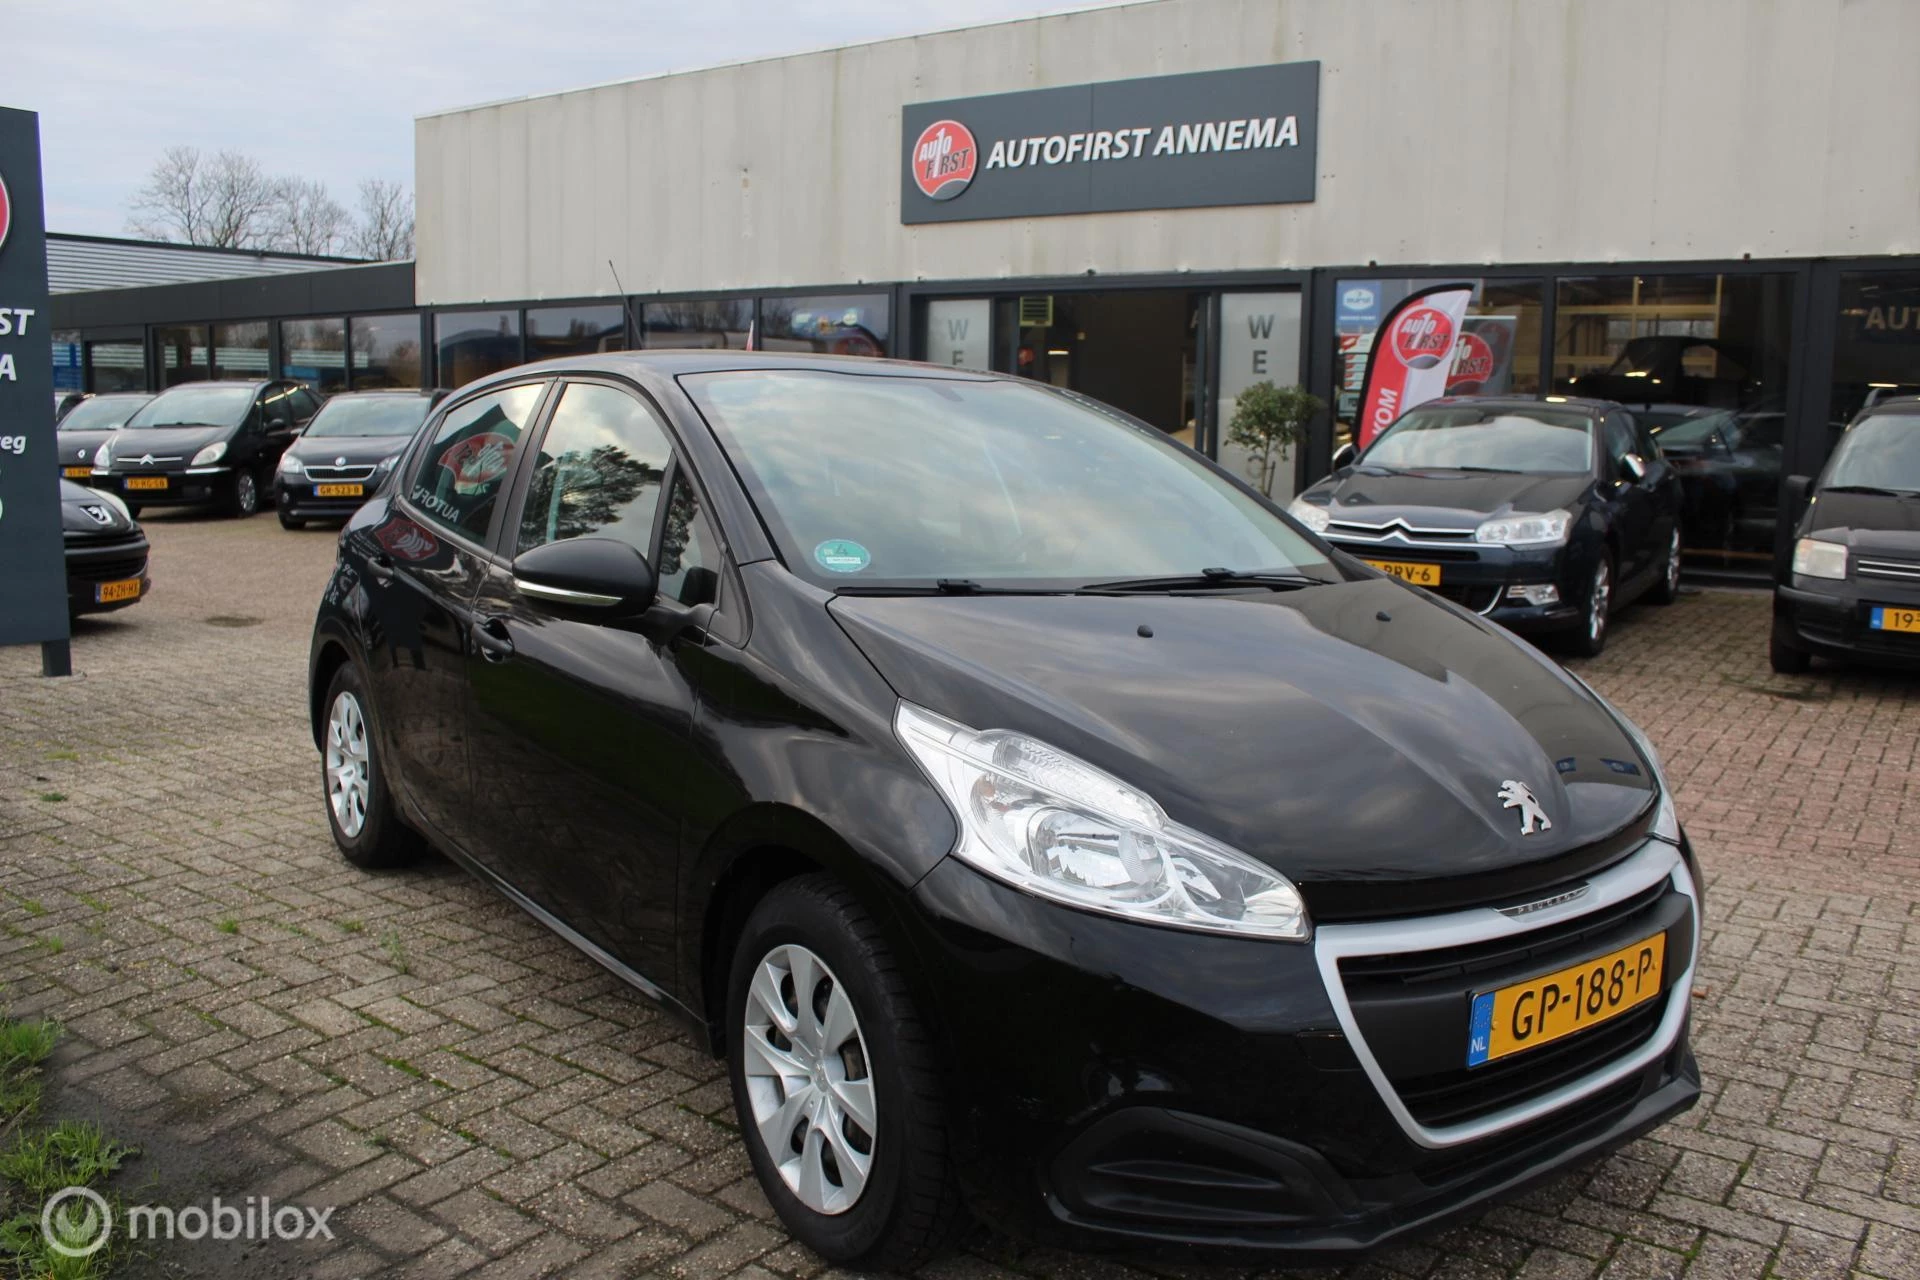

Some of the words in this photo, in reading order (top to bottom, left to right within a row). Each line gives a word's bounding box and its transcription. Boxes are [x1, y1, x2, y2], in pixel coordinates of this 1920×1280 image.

[985, 128, 1151, 169] AUTOFIRST
[1154, 115, 1299, 157] ANNEMA
[1511, 946, 1654, 1041] GP-188-P
[1471, 1036, 1487, 1053] NL
